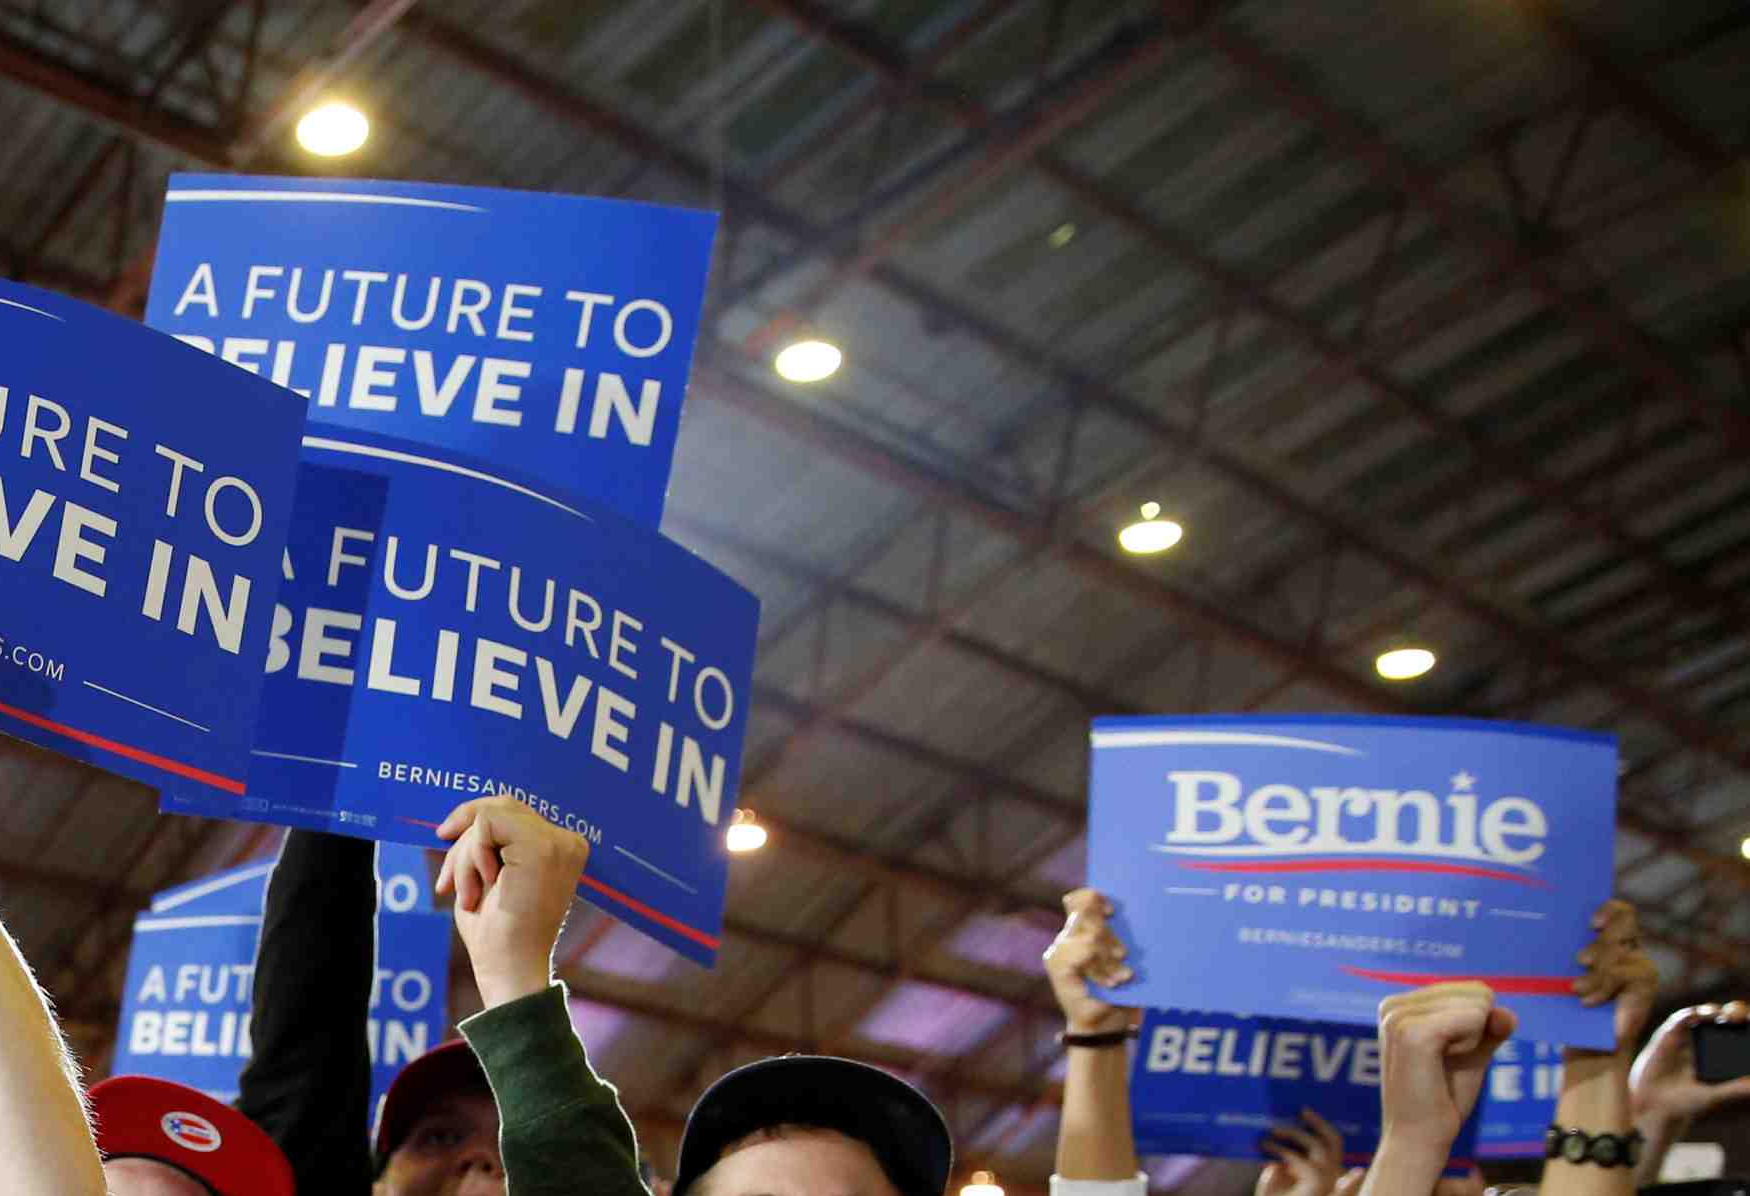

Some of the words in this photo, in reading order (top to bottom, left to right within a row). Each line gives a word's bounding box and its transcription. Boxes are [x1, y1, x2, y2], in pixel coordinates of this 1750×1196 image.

[174, 263, 219, 318] A
[242, 264, 542, 342] FUTURE
[564, 290, 674, 359] TO
[171, 335, 531, 428] LIEVE
[554, 368, 662, 447] IN
[154, 444, 264, 546] TO
[142, 539, 251, 655] IN
[327, 526, 647, 680] FUTURE
[659, 636, 734, 731] TO
[378, 761, 602, 844] BERNIESANDERS.COM
[651, 721, 726, 826] IN
[1165, 769, 1548, 865] Bernie
[1224, 884, 1287, 905] FOR
[1299, 888, 1481, 919] PRESIDENT
[138, 964, 167, 1004] A
[175, 964, 253, 1005] FUT
[129, 1010, 252, 1057] BELI
[367, 1020, 429, 1066] IN
[1146, 1024, 1382, 1086] BELIEVE
